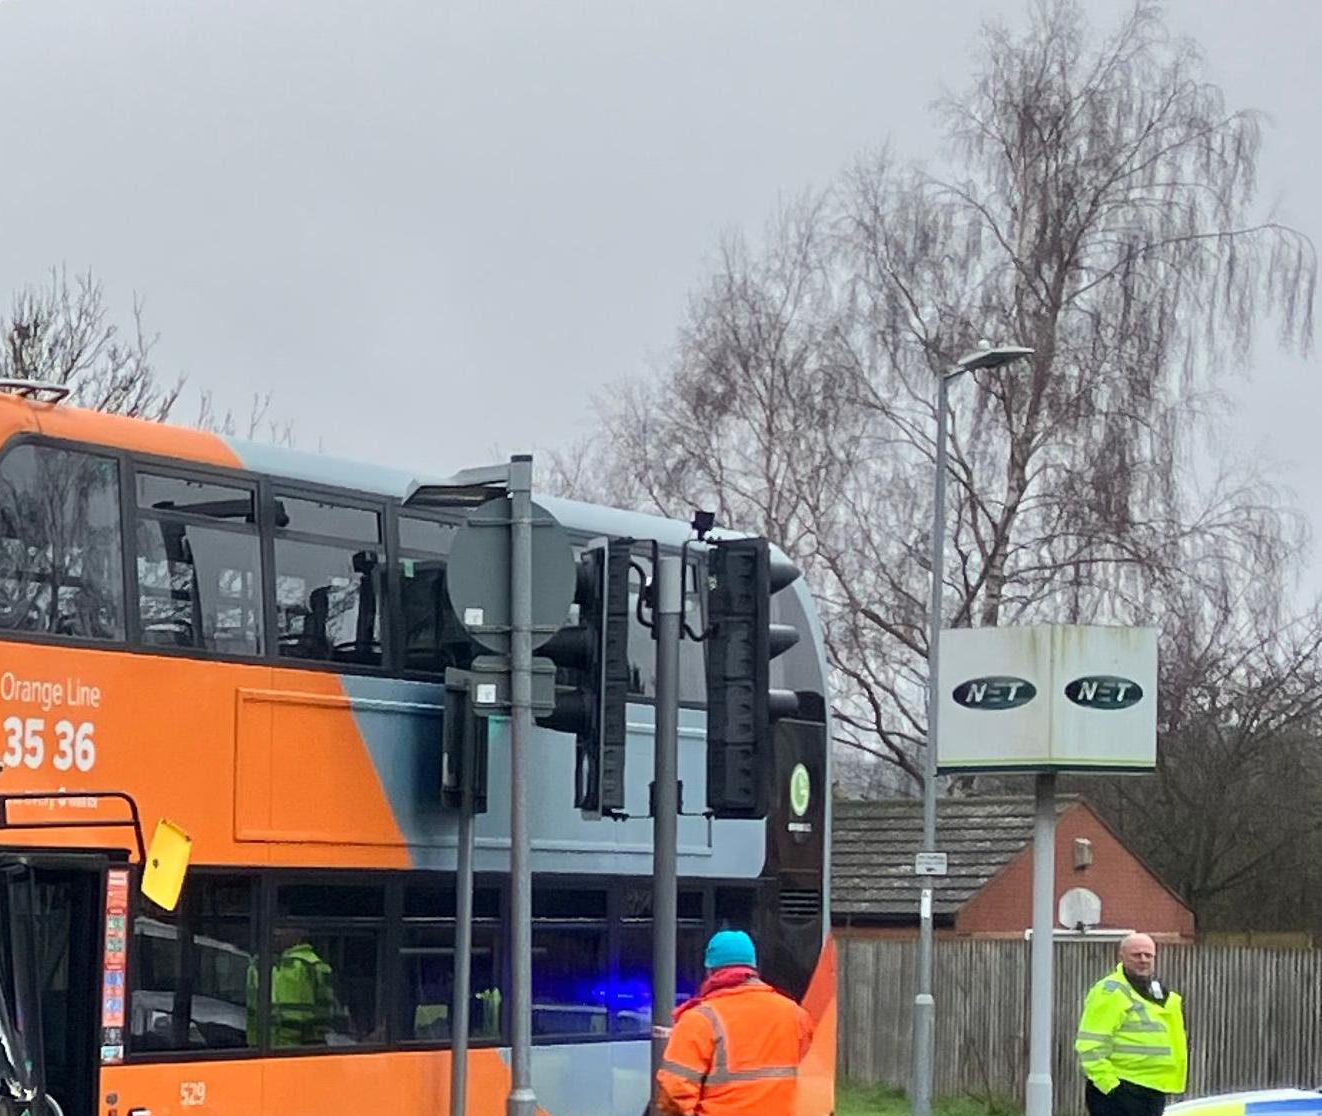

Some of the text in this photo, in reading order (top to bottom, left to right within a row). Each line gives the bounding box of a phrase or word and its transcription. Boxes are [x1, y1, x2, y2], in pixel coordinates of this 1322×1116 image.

[0, 672, 100, 711] Orange Line
[965, 682, 1025, 702] NET
[1077, 681, 1133, 702] NET
[3, 716, 95, 772] 35 36
[180, 1081, 206, 1106] 529
